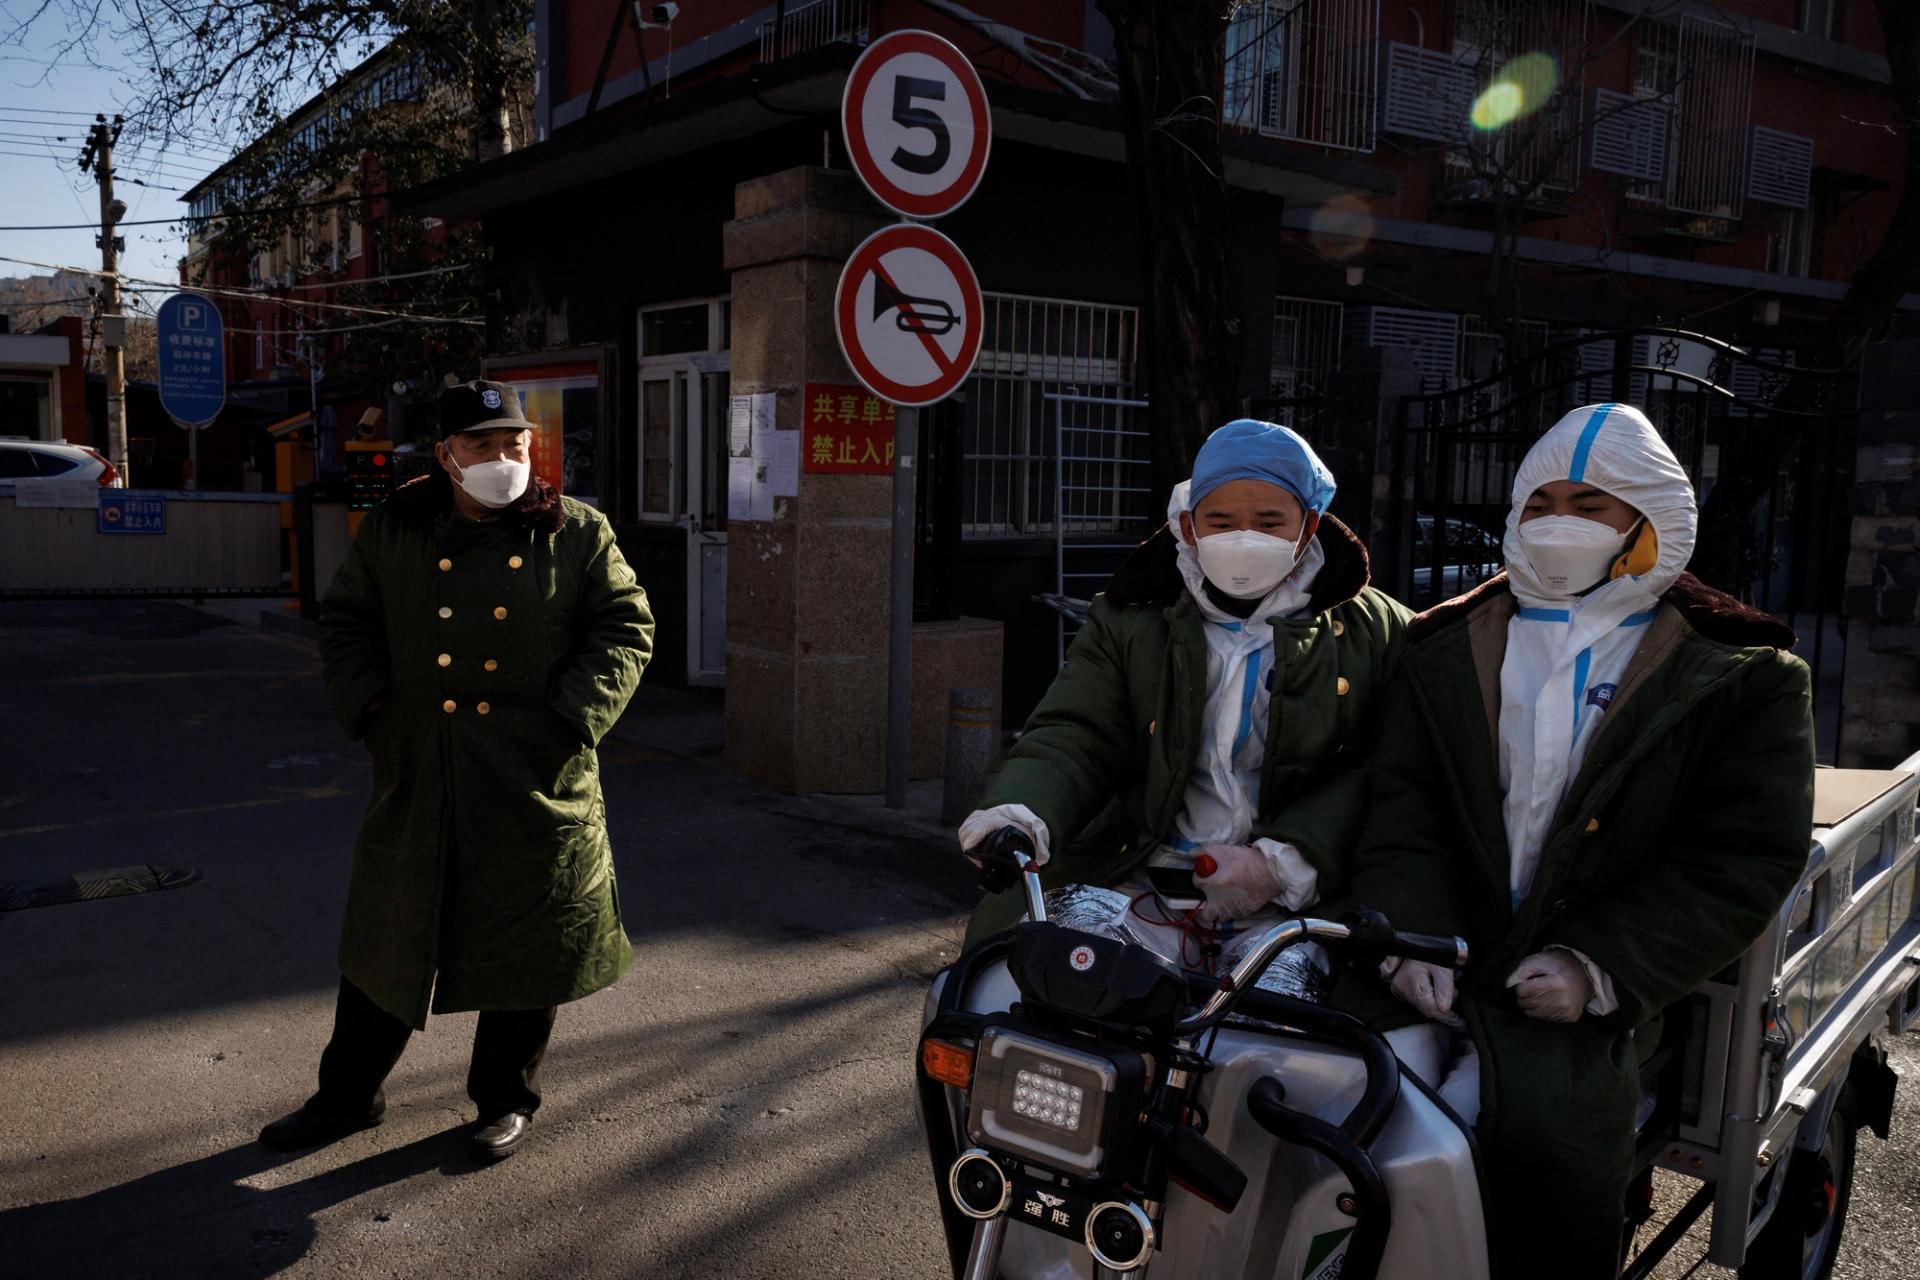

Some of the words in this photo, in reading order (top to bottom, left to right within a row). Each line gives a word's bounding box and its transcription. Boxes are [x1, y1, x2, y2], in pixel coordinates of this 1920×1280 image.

[890, 74, 951, 175] 5
[183, 305, 200, 328] P
[124, 515, 161, 529] 禁止入内
[1023, 1199, 1071, 1228] 强胜
